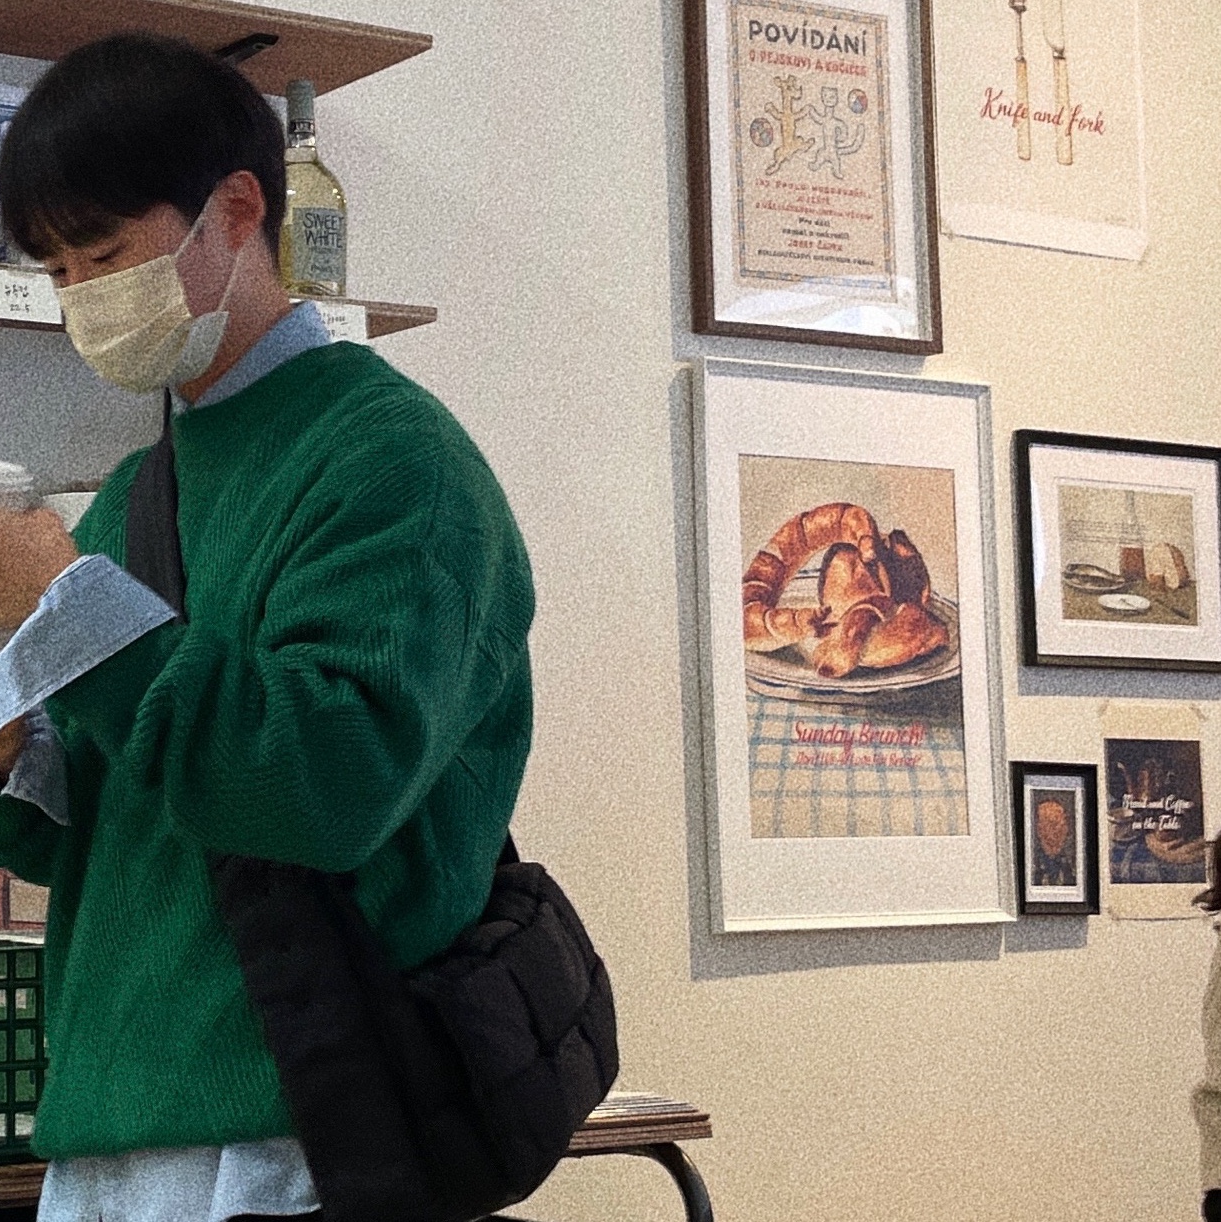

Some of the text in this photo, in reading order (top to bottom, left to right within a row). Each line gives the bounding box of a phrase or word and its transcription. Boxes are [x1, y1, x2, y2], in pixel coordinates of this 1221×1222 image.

[749, 19, 867, 57] POVÍDÁNÍ
[980, 86, 1106, 137] Knife and fork
[303, 212, 346, 231] SWEET
[304, 230, 343, 249] WHITE
[794, 720, 856, 756] Sunday
